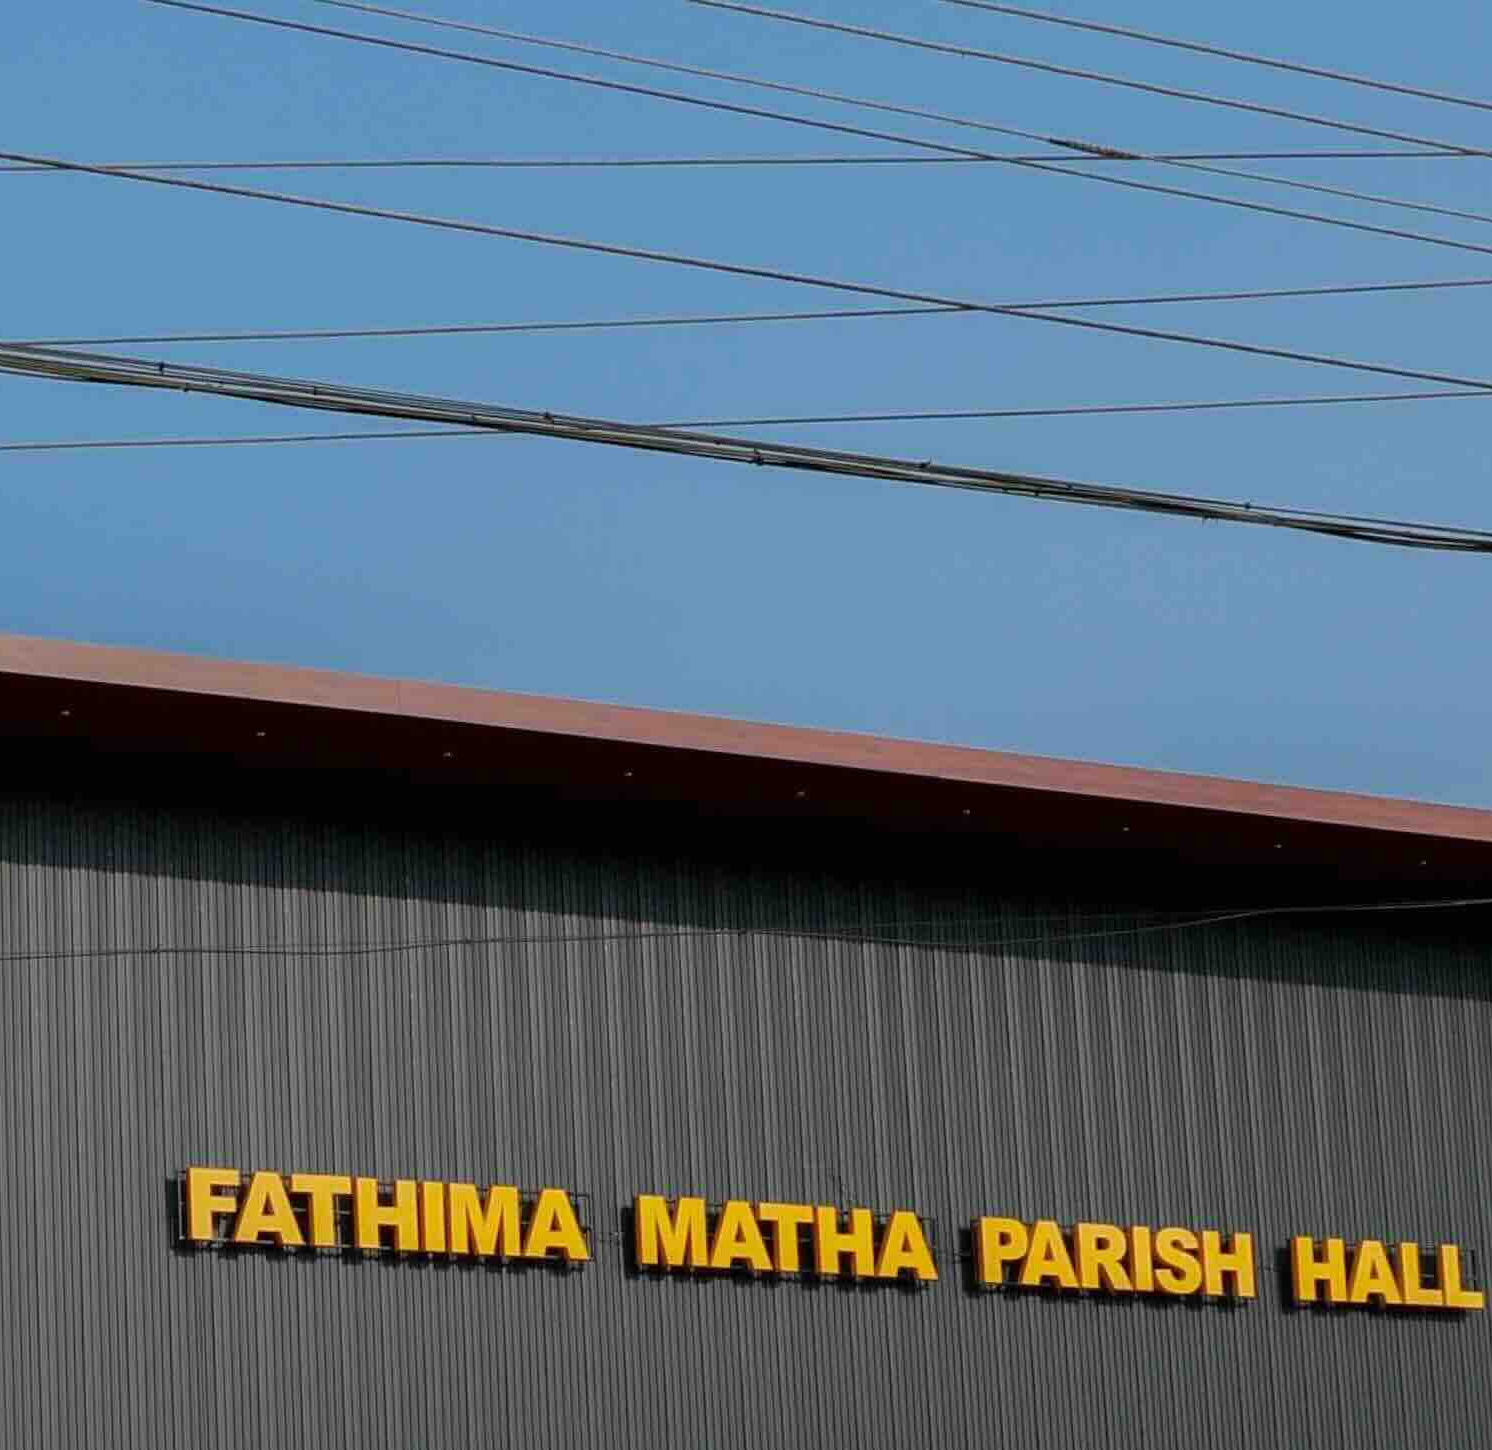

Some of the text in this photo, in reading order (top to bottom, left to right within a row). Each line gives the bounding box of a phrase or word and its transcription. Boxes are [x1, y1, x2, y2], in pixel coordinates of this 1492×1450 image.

[186, 1166, 1486, 1310] FATHIMA MATHA PARISH HALL
